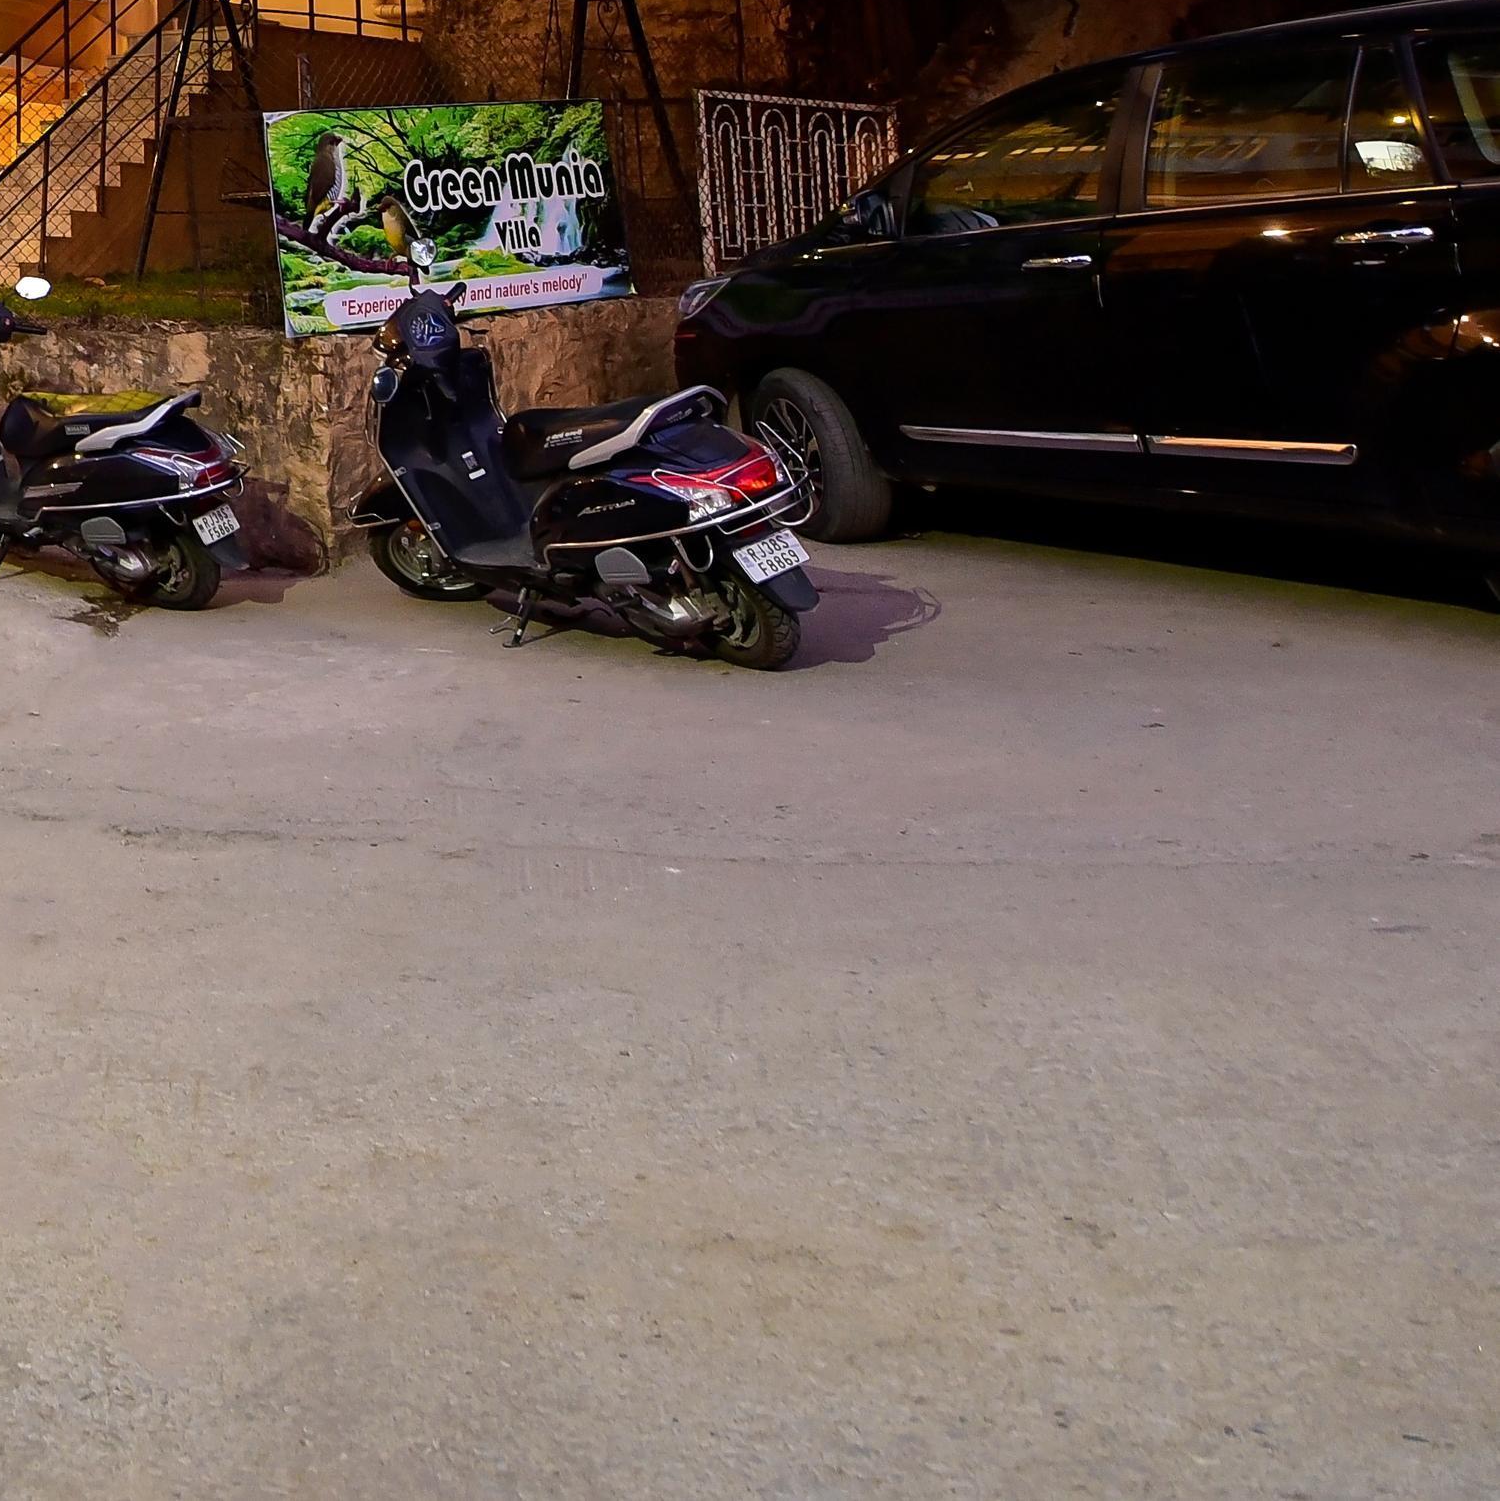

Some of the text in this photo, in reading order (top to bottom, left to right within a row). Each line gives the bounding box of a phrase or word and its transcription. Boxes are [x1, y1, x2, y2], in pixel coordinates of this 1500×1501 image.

[404, 150, 605, 213] Green Munia
[494, 217, 543, 255] Villa
[341, 296, 405, 318] "Experien
[470, 284, 492, 301] and
[495, 279, 540, 299] nature's
[542, 274, 588, 293] melody"
[202, 508, 229, 530] RJ38S
[208, 519, 235, 541] F5866
[746, 535, 790, 564] RJ38S
[757, 549, 800, 577] F8869
